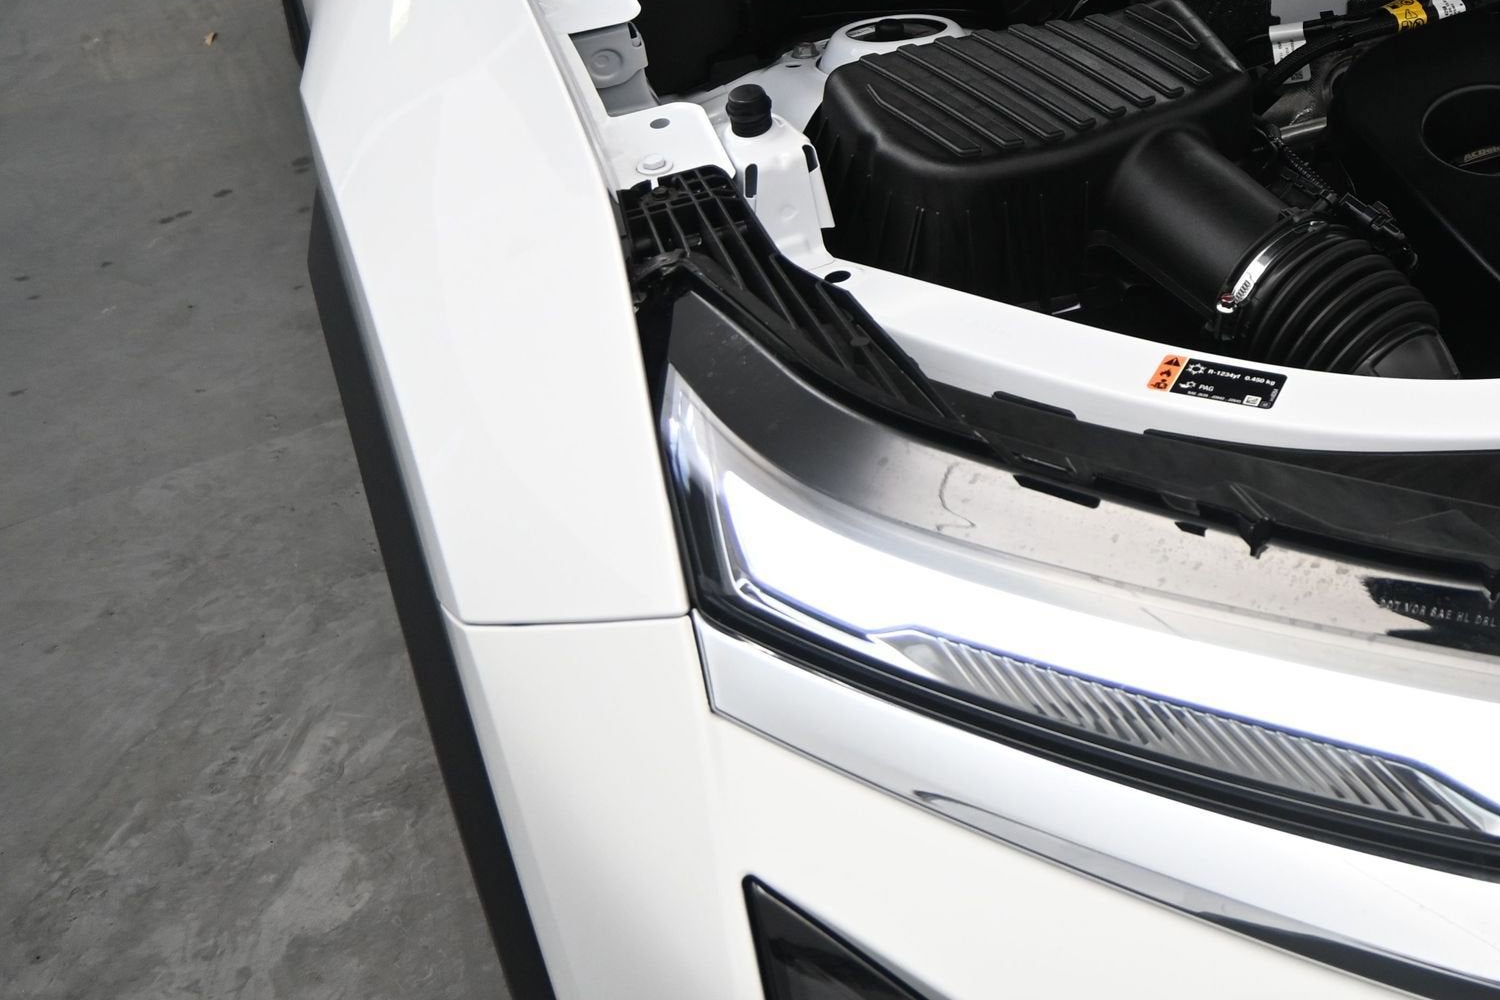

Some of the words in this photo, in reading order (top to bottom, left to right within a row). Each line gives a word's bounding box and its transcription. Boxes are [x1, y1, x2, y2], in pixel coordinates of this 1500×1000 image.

[1208, 369, 1241, 379] R-1234yf
[1244, 375, 1265, 384] 0.450
[1198, 384, 1215, 392] PAG
[1429, 606, 1453, 620] SAE
